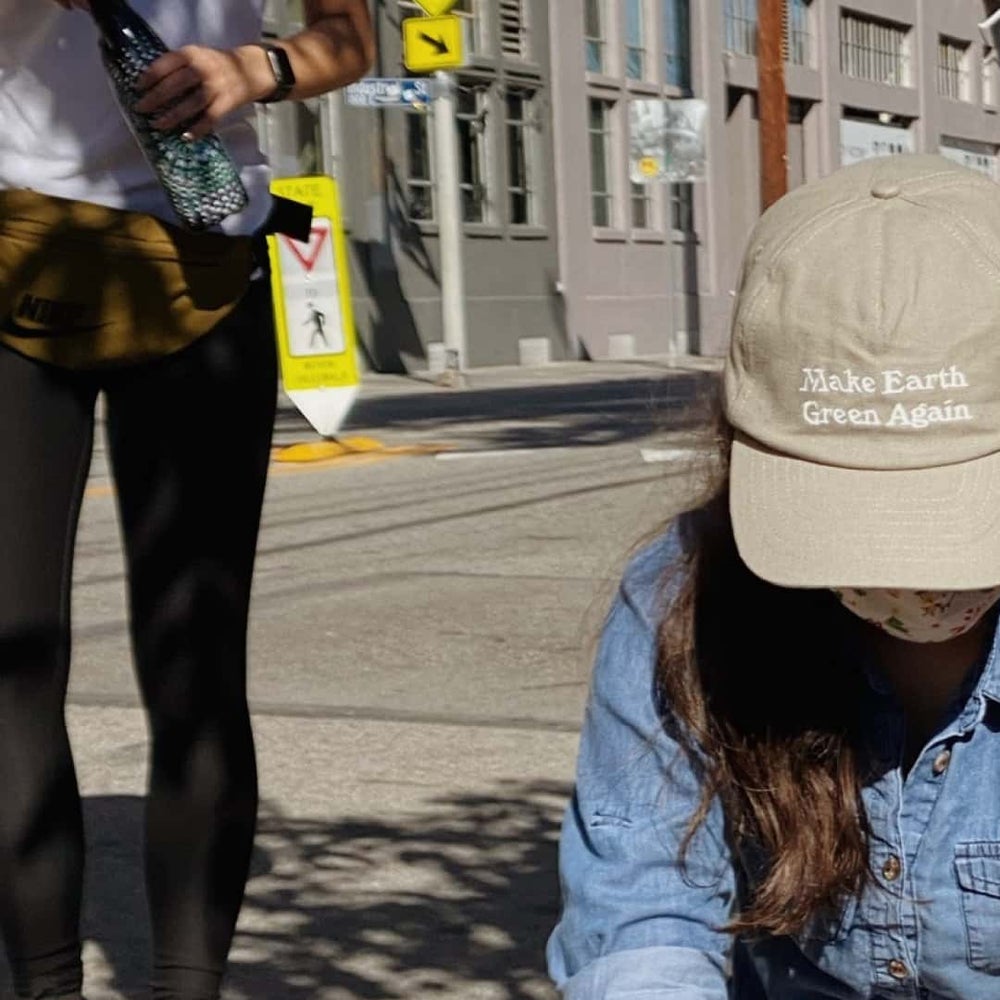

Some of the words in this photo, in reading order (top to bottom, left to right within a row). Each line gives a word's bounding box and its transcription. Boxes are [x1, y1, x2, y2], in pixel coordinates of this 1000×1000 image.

[799, 367, 876, 393] Make
[881, 364, 969, 395] Earth
[802, 400, 881, 426] Green
[885, 400, 973, 429] Again
